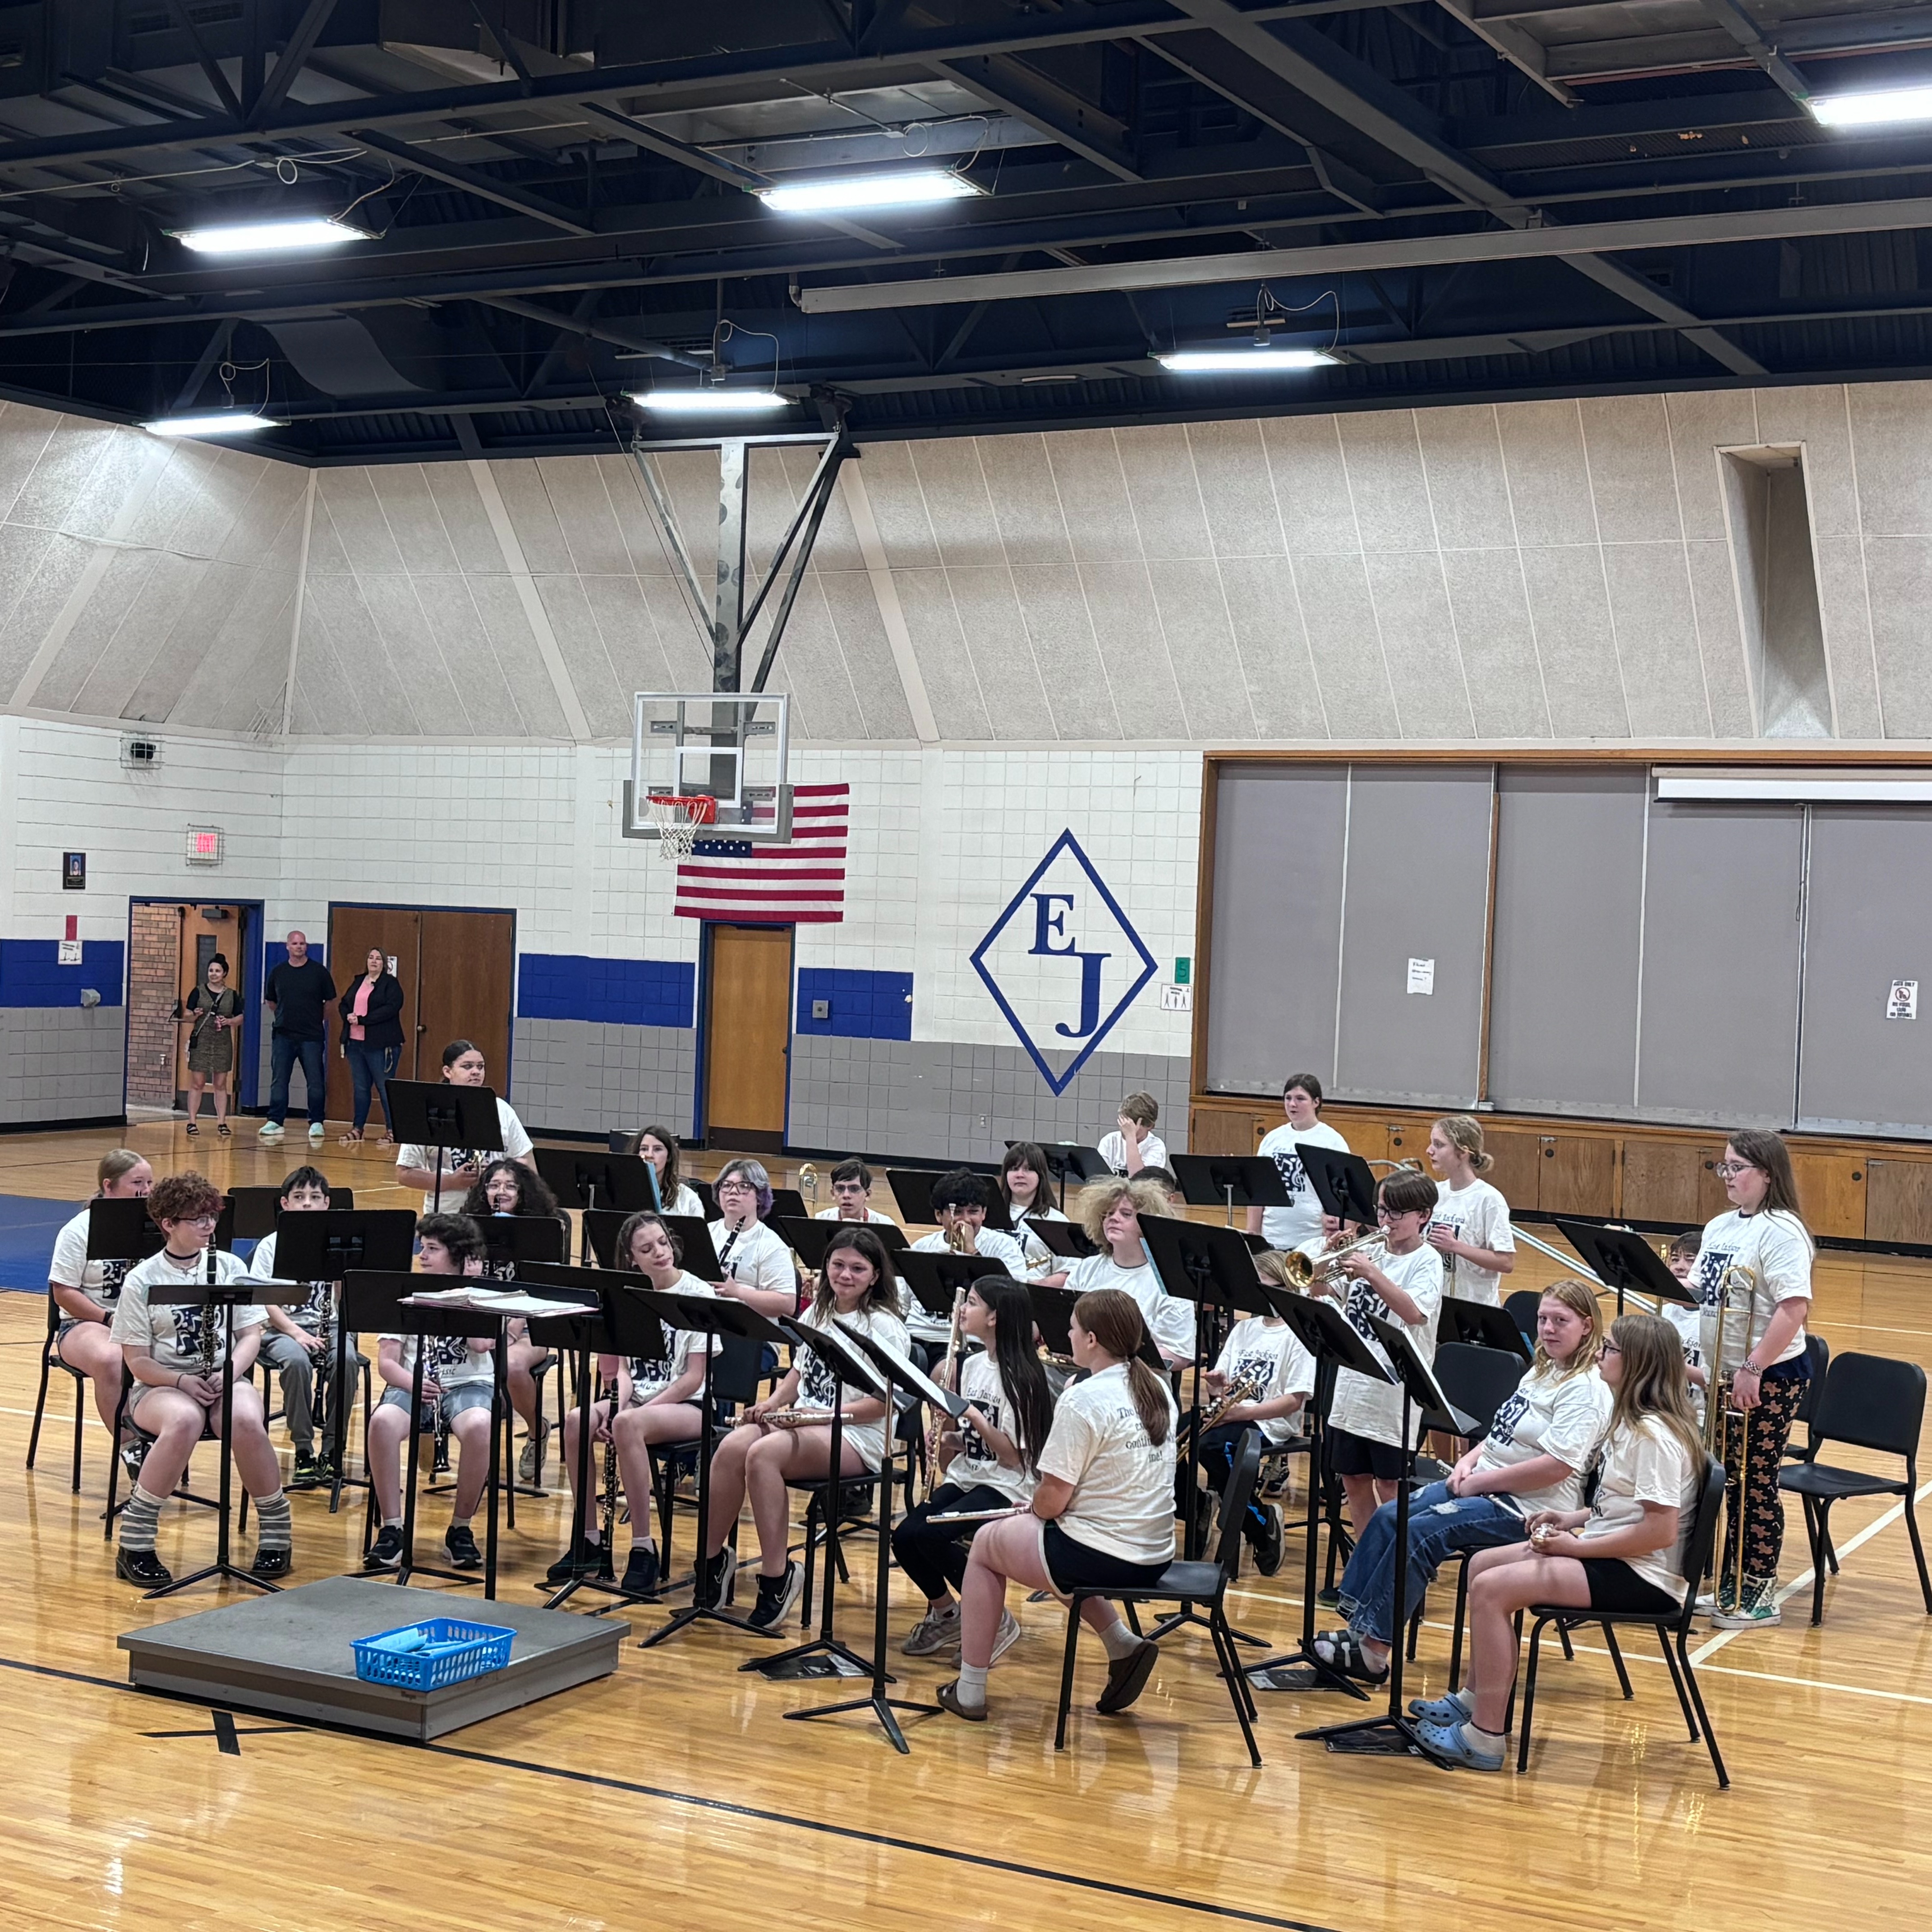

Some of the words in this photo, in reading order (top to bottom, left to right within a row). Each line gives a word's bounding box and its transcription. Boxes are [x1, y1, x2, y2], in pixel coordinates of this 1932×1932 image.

[1027, 892, 1076, 955] E
[1055, 952, 1111, 1038] J
[1117, 1407, 1134, 1419] The
[1126, 1435, 1151, 1449] contin
[1149, 1450, 1163, 1463] me!
